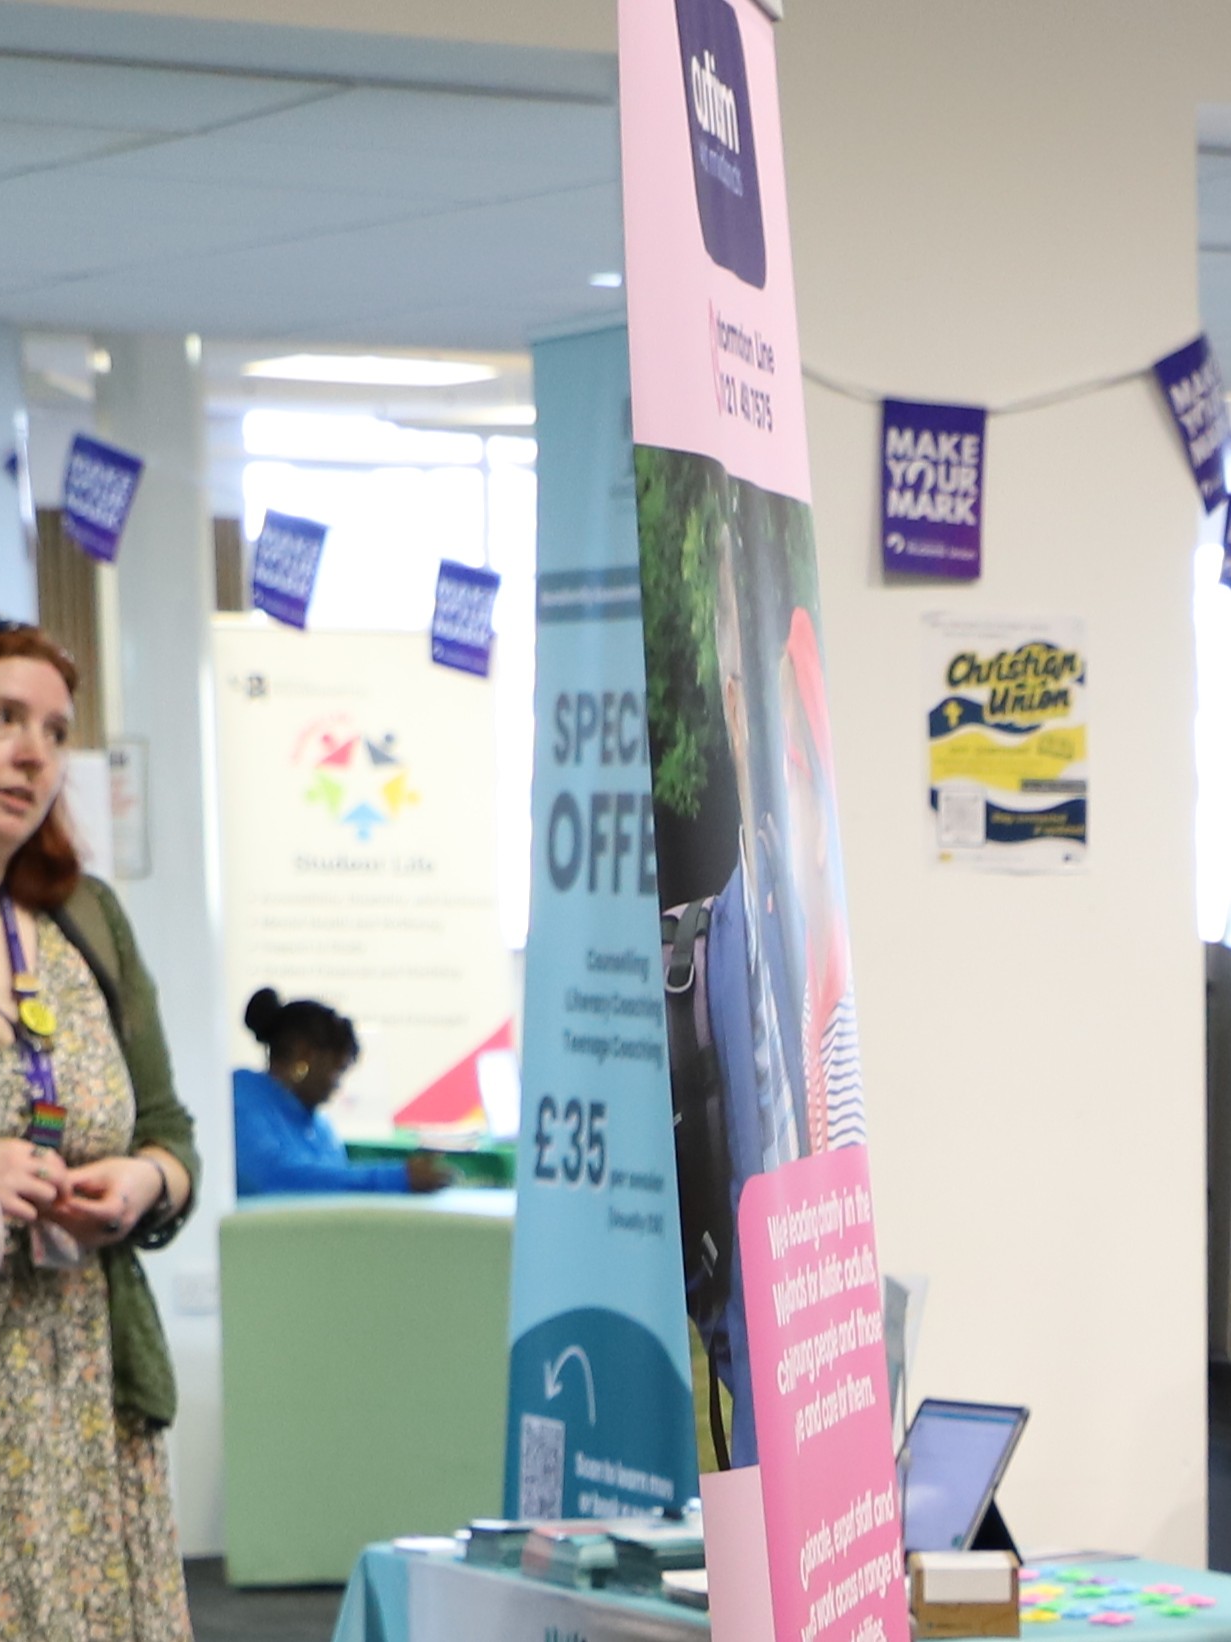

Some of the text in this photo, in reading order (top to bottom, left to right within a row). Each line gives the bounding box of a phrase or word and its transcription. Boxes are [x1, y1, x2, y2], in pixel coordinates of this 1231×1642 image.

[886, 426, 980, 464] MAKE
[887, 459, 979, 498] YOUR
[886, 488, 977, 526] MARK
[945, 650, 1077, 689] Christian
[989, 683, 1071, 716] Union
[552, 690, 649, 767] SPECI
[547, 792, 657, 896] OFFE
[533, 1095, 608, 1187] £35
[843, 1186, 856, 1228] in
[837, 1308, 856, 1356] and
[804, 1390, 822, 1439] and
[873, 1480, 895, 1528] and
